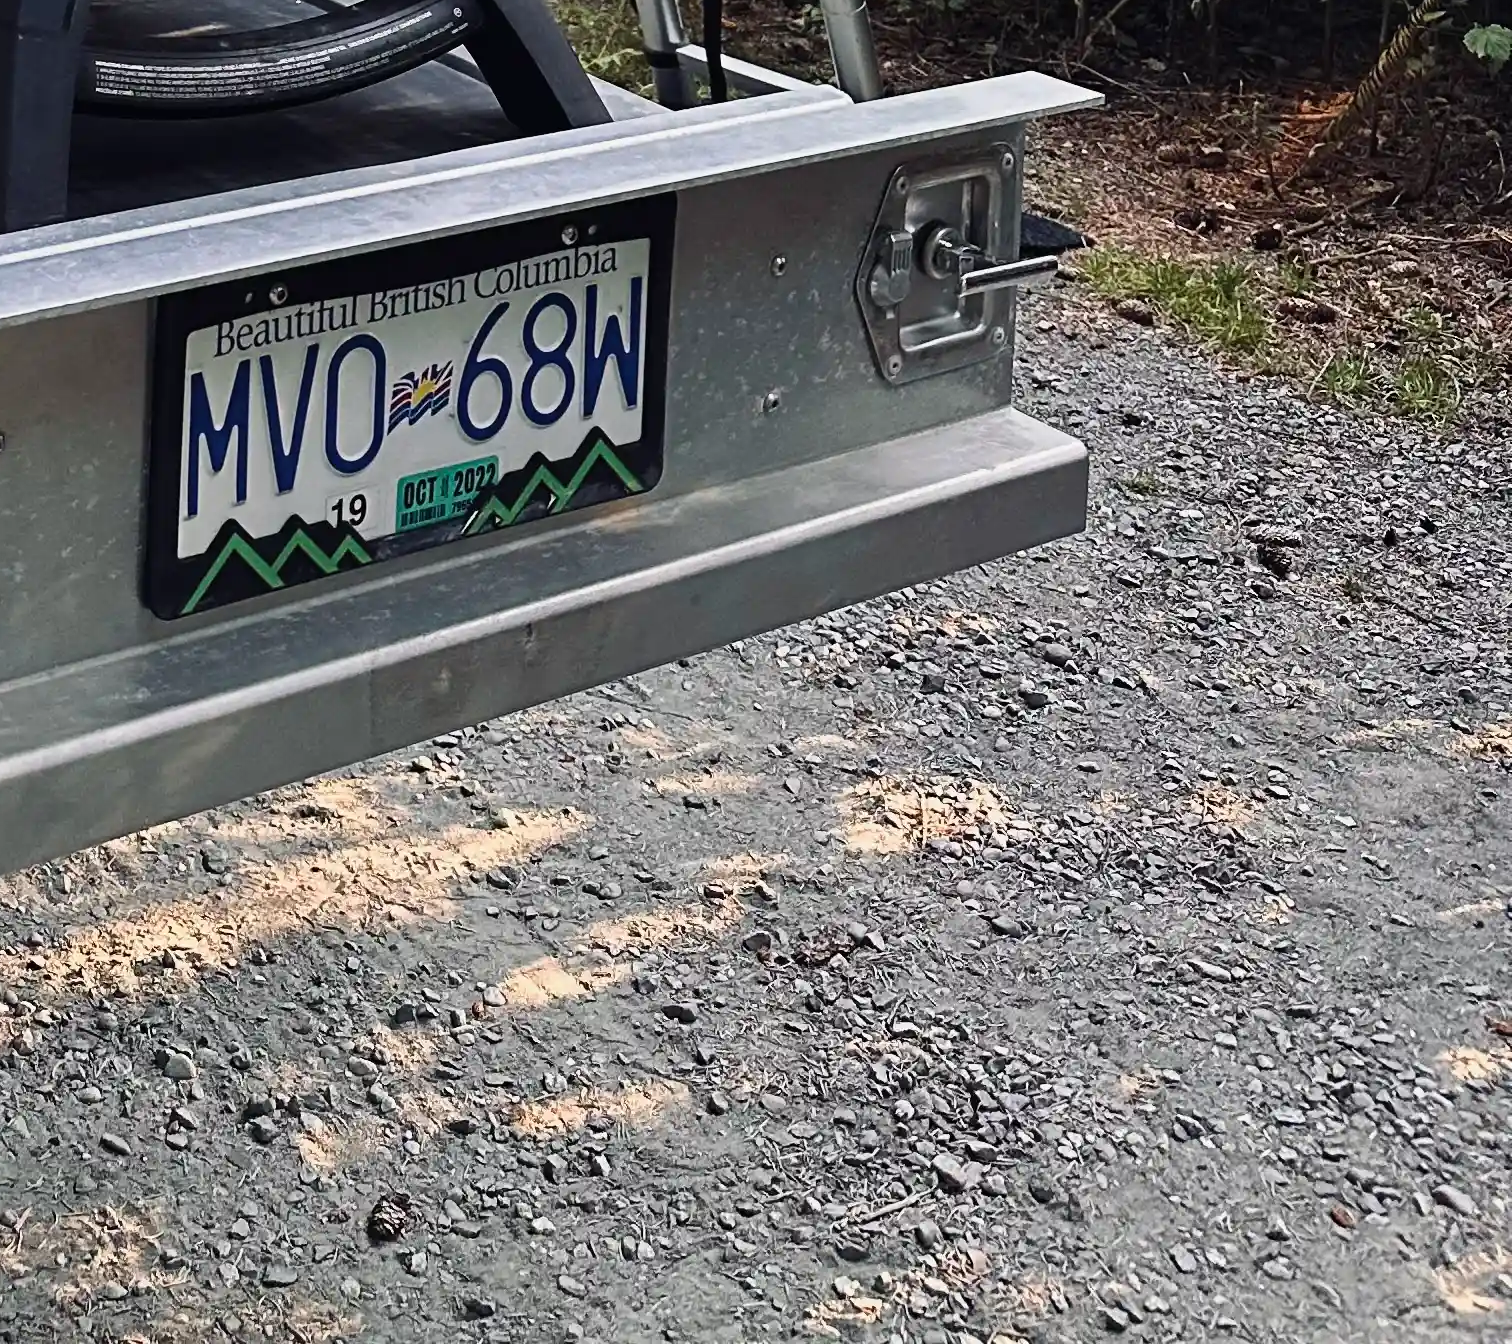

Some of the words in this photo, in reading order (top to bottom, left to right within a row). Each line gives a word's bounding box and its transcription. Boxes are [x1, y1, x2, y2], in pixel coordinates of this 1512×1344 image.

[213, 296, 358, 359] Beautiful
[367, 276, 466, 322] British
[474, 244, 618, 298] Columbia
[456, 276, 642, 443] 68W
[331, 493, 369, 527] 19
[404, 476, 437, 510] OCT
[453, 462, 496, 498] 2022
